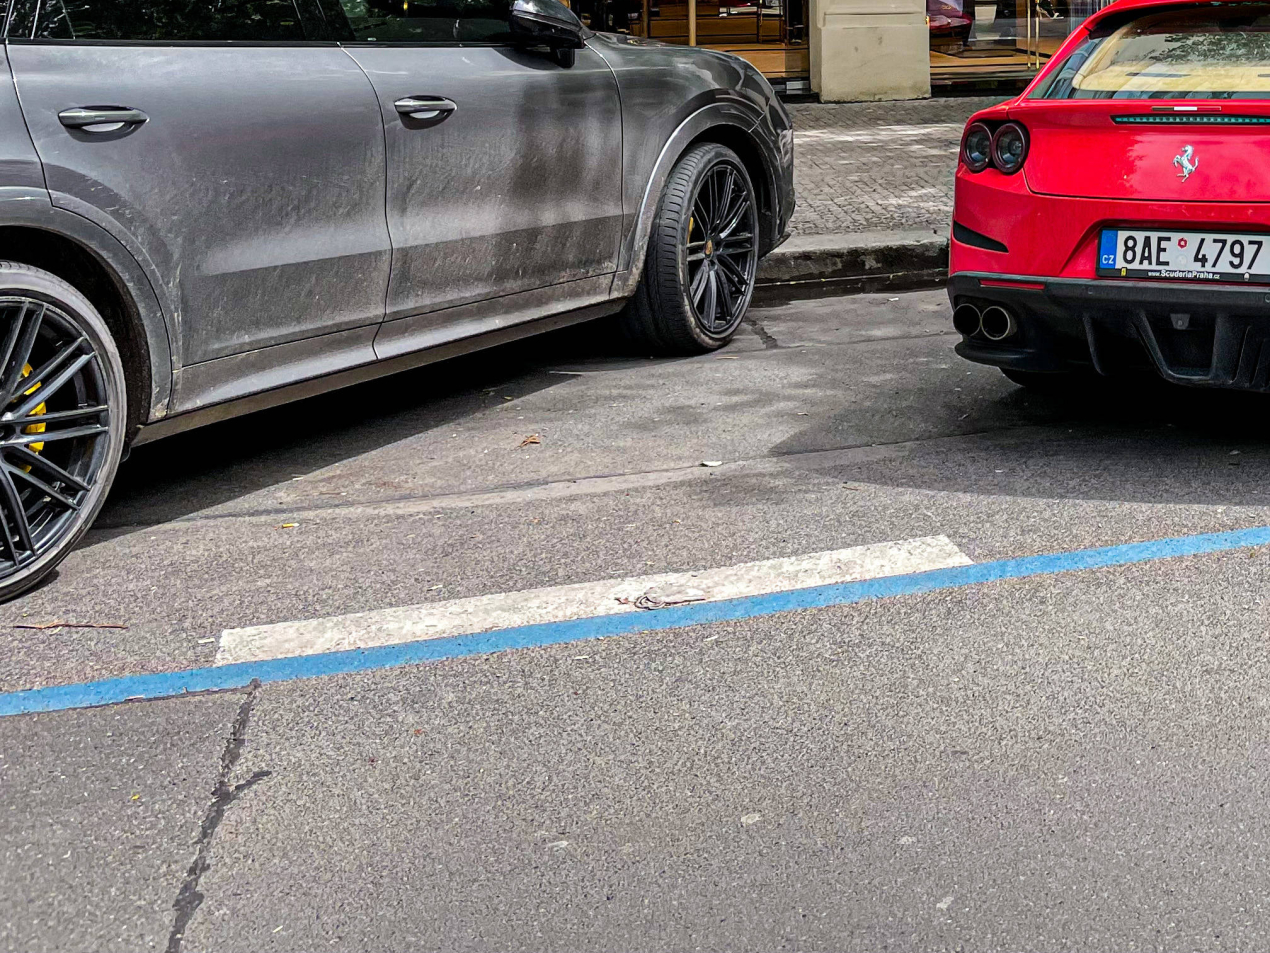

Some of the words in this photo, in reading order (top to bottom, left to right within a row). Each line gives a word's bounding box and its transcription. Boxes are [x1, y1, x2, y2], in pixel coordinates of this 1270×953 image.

[1102, 254, 1115, 264] CZ
[1123, 235, 1171, 266] 8AE
[1193, 237, 1264, 270] 4797
